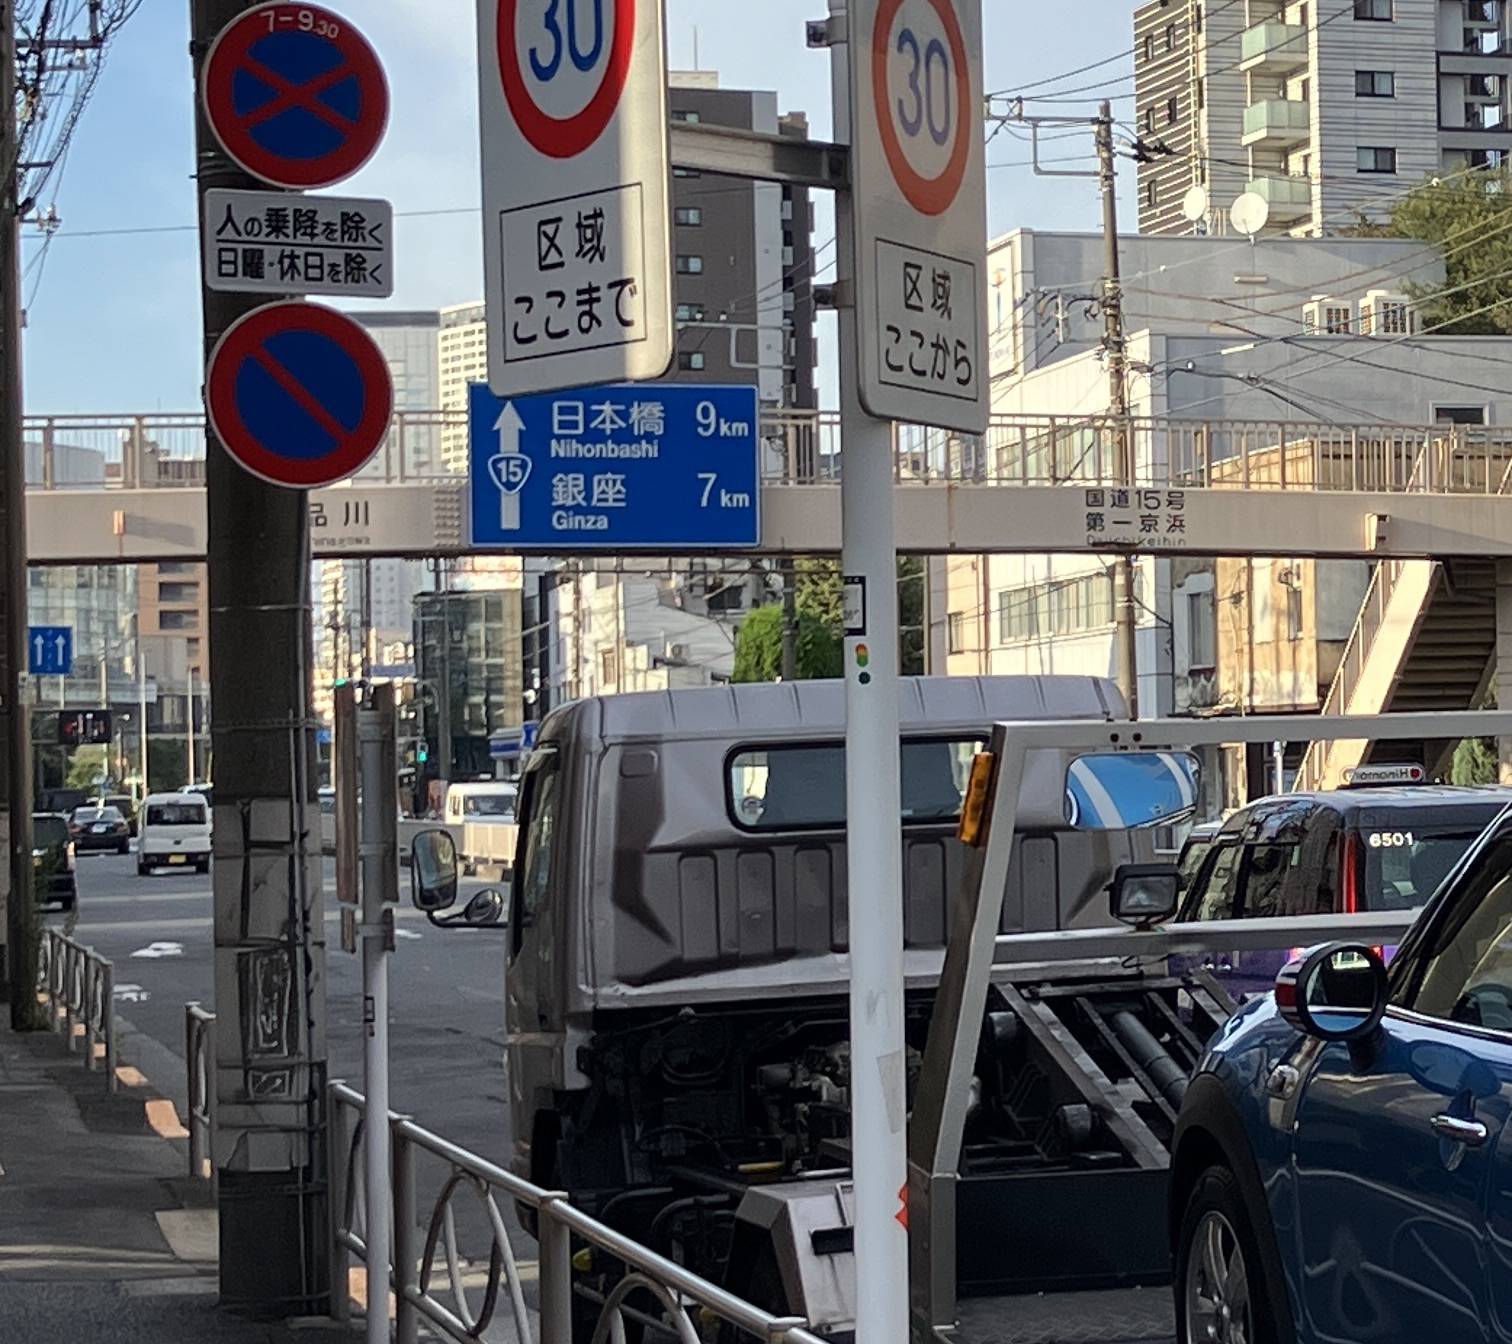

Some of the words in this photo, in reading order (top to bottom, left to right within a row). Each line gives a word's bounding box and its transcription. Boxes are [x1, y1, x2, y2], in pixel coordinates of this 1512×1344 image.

[897, 27, 951, 146] 30
[215, 203, 384, 245] 人の乗降を除く
[537, 206, 607, 272] 区域
[903, 261, 952, 321] 区域
[513, 276, 638, 345] ここまで
[885, 324, 972, 387] ここから
[551, 400, 666, 436] 日本橋
[550, 439, 660, 459] Nihonbashi
[496, 459, 523, 484] 15
[551, 471, 628, 507] 銀座
[1085, 488, 1185, 511] 国道15号
[551, 510, 609, 531] Ginza
[1085, 512, 1186, 534] 第一京浜
